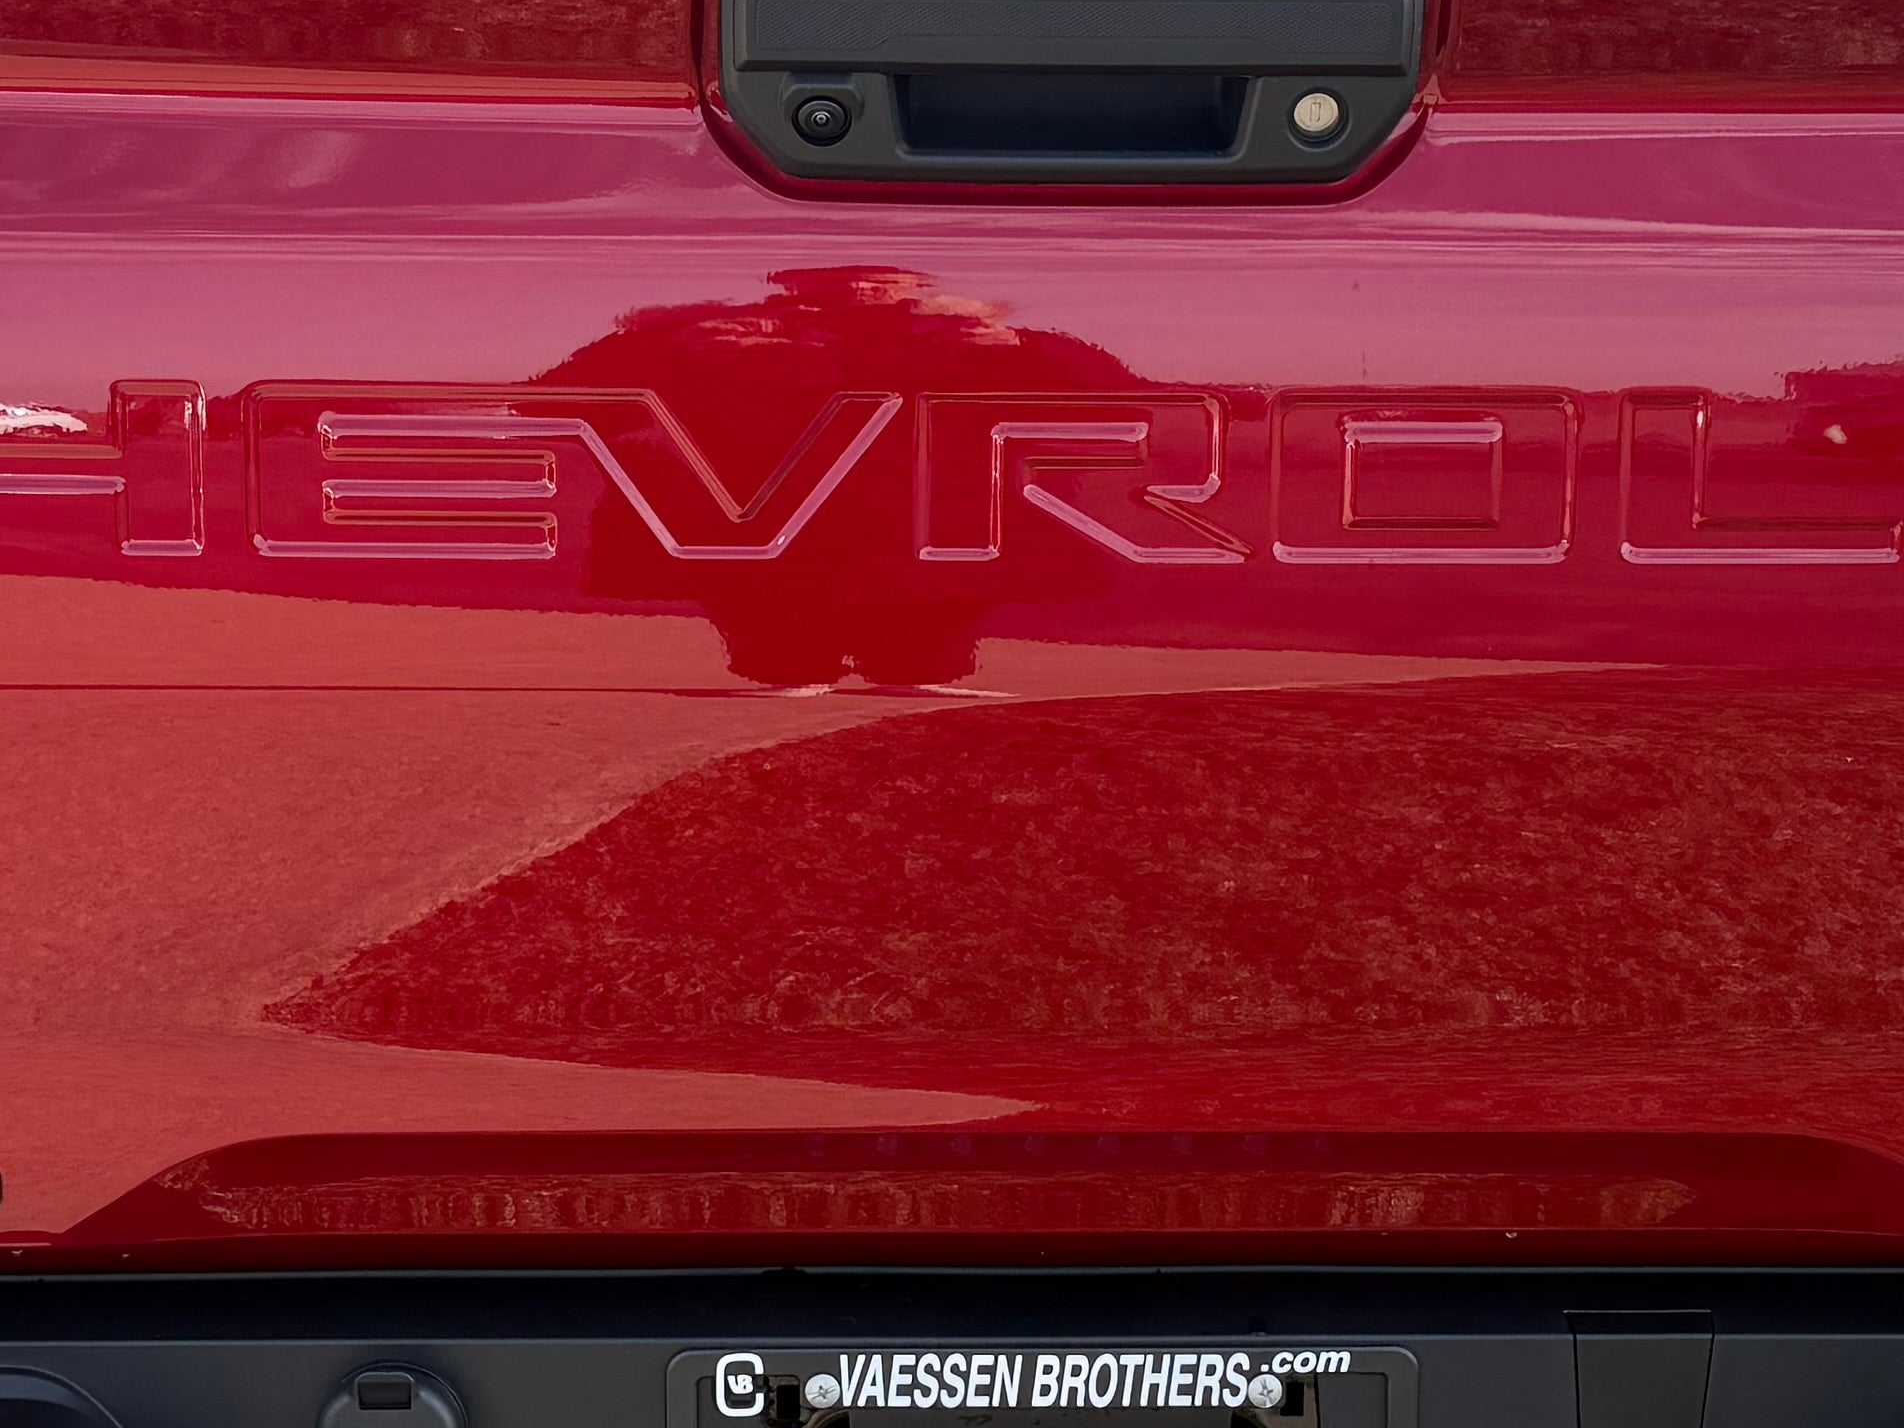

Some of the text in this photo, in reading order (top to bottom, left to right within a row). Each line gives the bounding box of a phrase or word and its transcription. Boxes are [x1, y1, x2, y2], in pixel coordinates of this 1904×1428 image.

[839, 1350, 1351, 1409] VAESSEN BROTHERS .com
